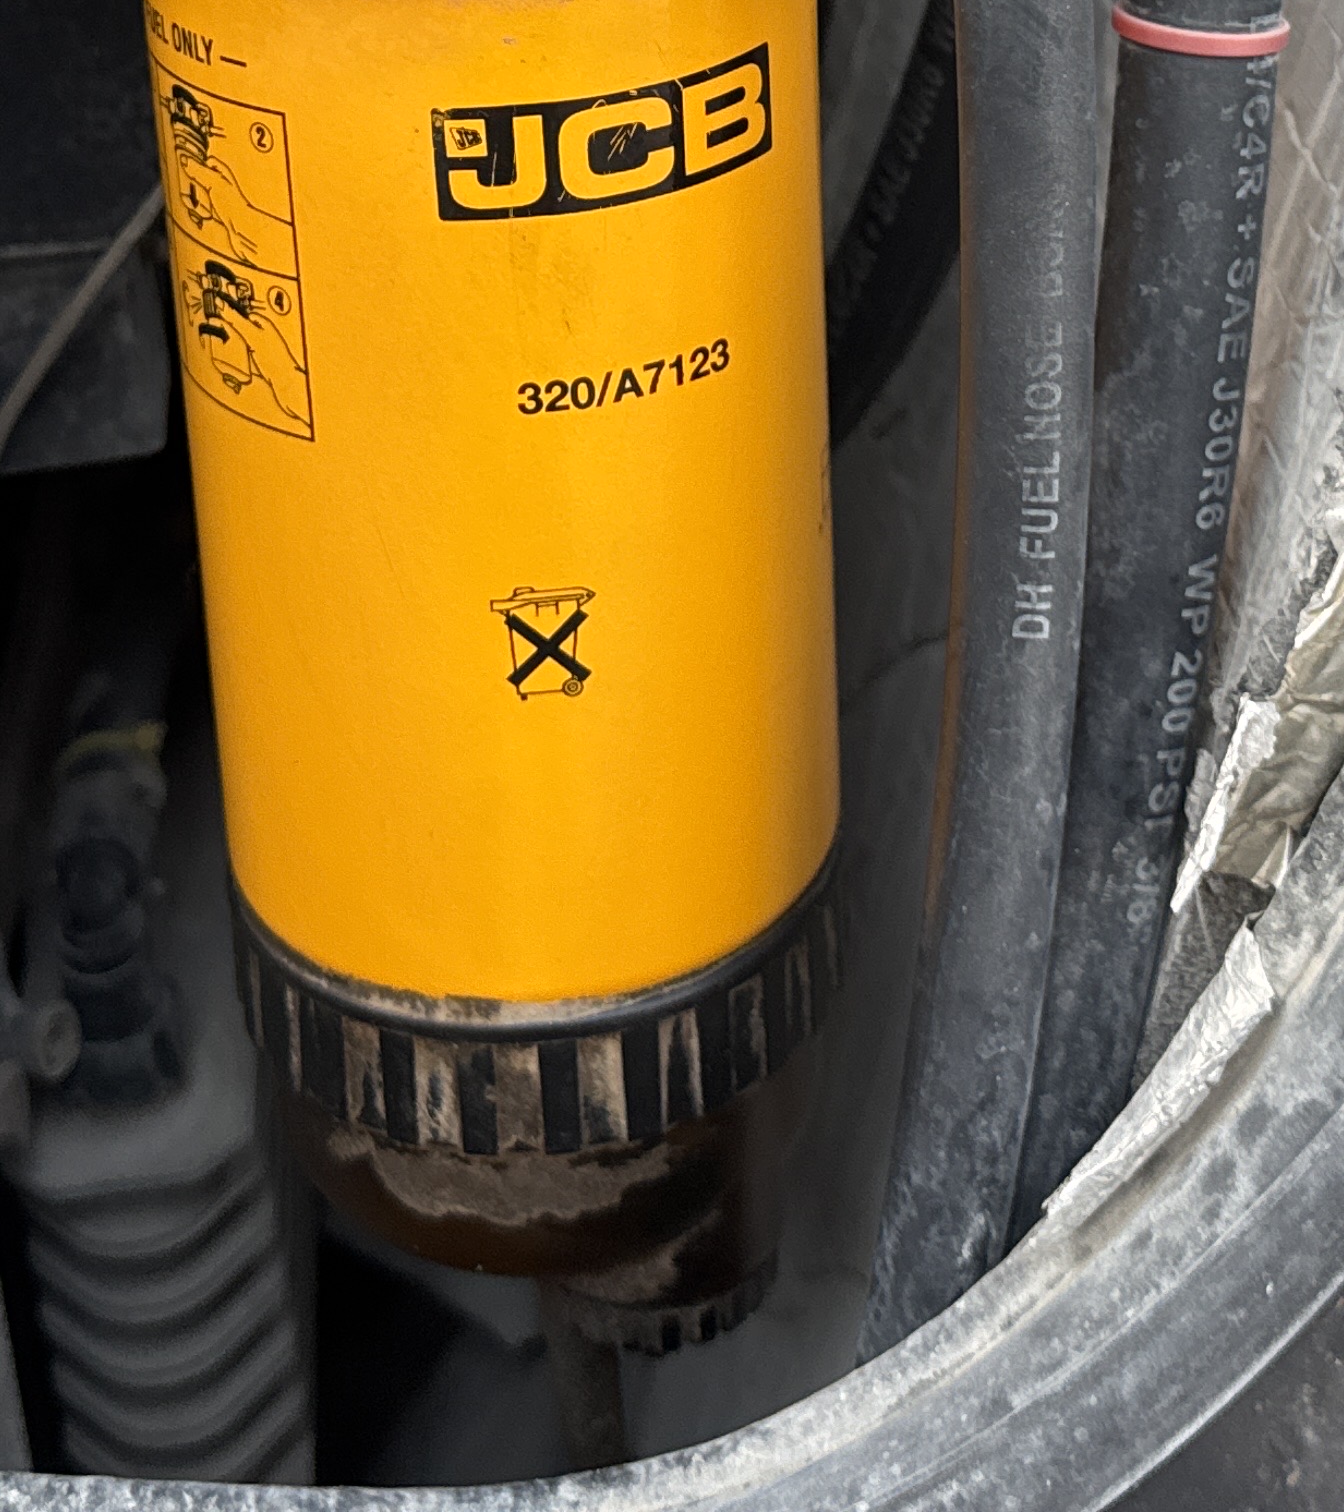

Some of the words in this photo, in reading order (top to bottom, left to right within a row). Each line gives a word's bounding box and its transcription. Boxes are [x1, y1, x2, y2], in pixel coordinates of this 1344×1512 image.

[171, 21, 214, 66] ONLY
[444, 62, 766, 210] JCB
[1217, 256, 1256, 364] SAE
[517, 337, 731, 416] 320/A7123
[1195, 376, 1241, 531] J30R6
[1018, 451, 1061, 560] FUEL
[1181, 553, 1218, 636] WP
[1161, 649, 1202, 733] 200
